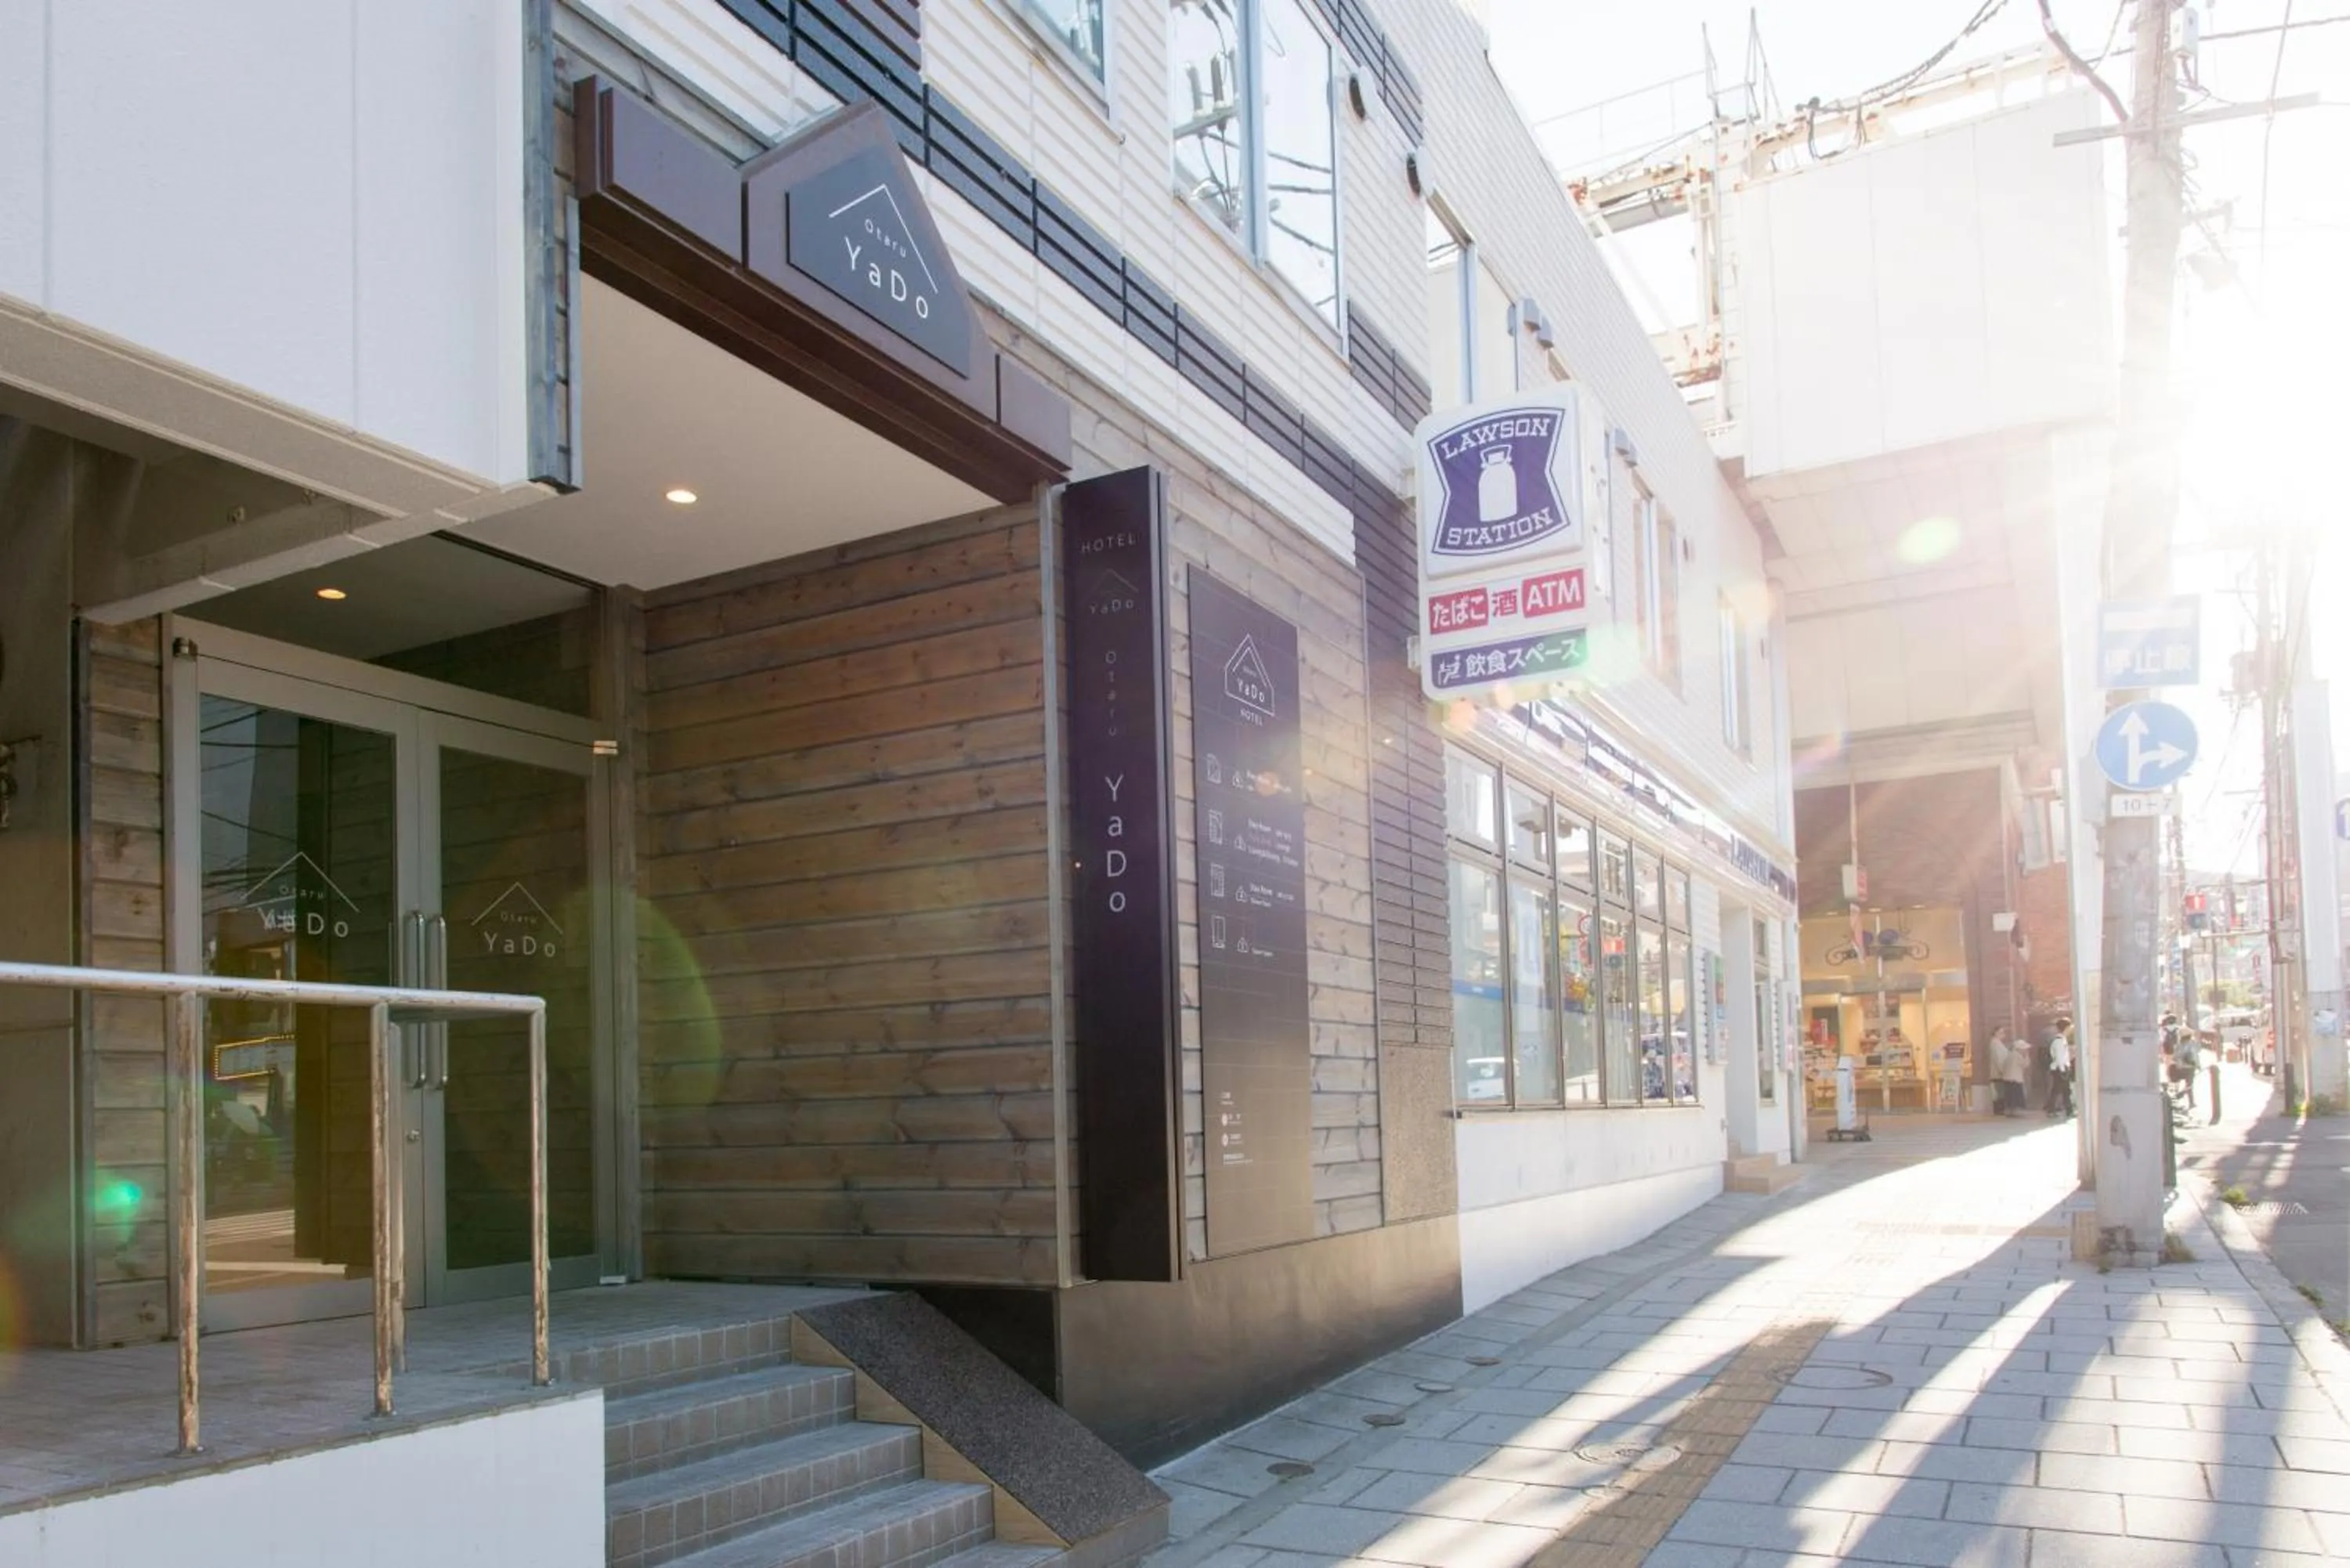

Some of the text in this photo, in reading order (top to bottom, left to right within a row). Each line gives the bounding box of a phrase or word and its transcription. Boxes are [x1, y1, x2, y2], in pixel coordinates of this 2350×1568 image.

[864, 218, 906, 258] Otaru
[844, 236, 929, 319] YaDo
[1441, 417, 1551, 460] LAWSON
[1081, 532, 1137, 553] HOTEL
[1446, 508, 1553, 547] STATION
[1432, 577, 1581, 629] たばこ 酒 ATM
[1465, 638, 1581, 678] 飲食スペース
[1104, 773, 1127, 913] YaDo
[483, 930, 555, 957] YaDo
